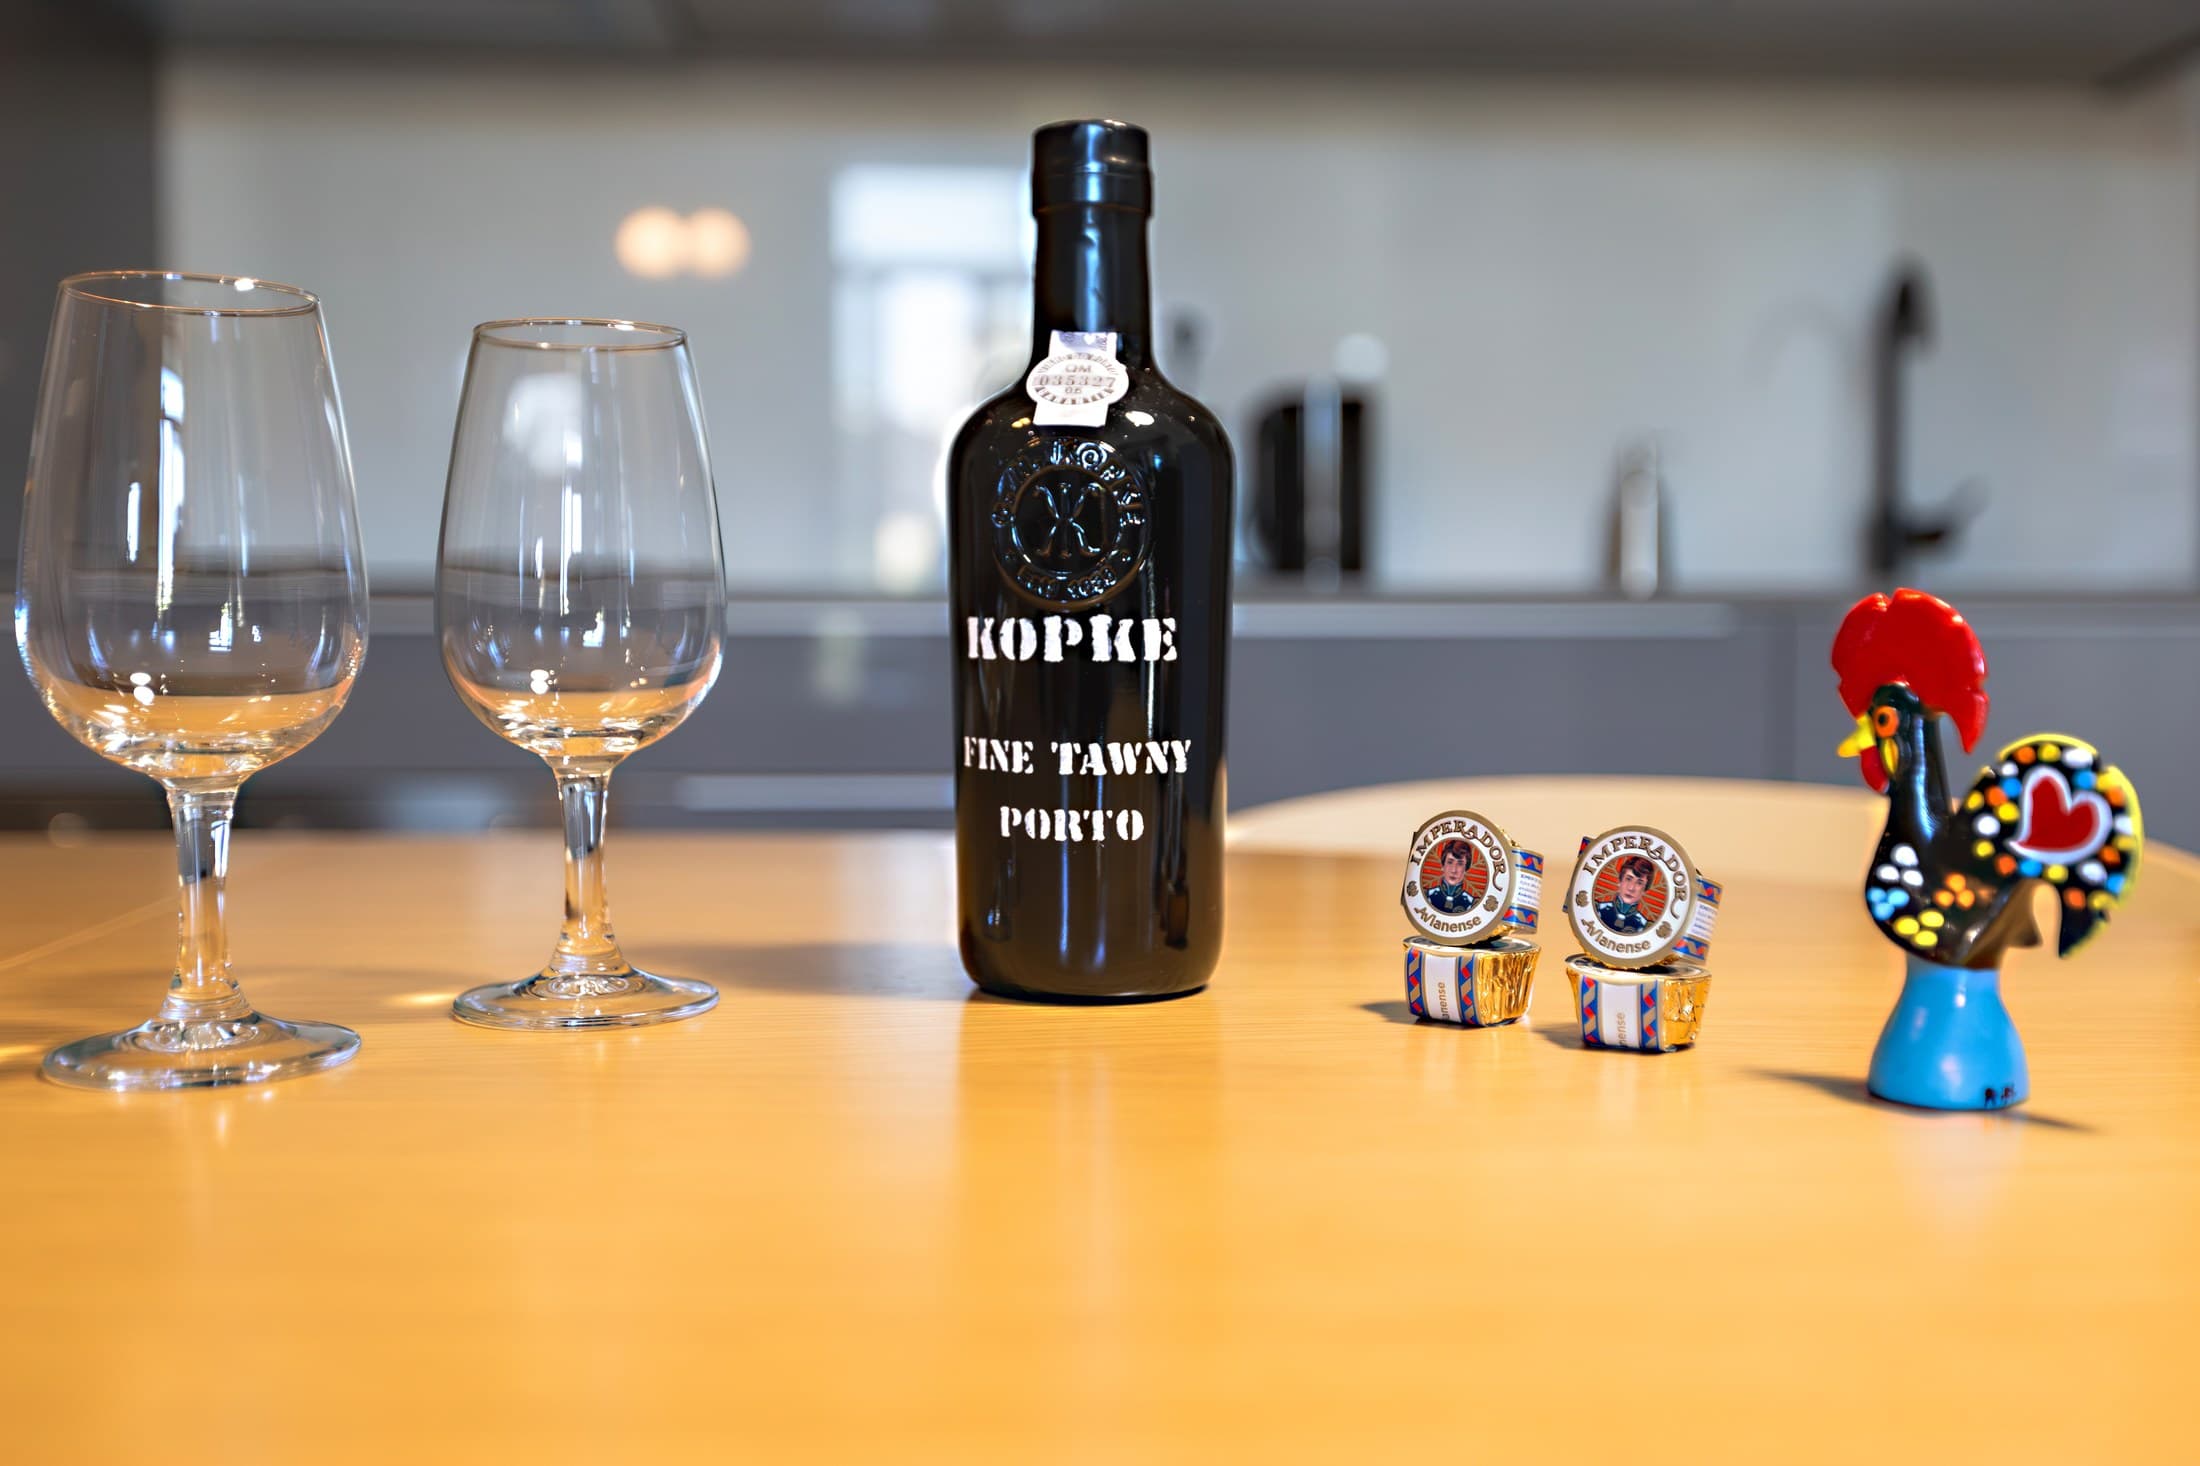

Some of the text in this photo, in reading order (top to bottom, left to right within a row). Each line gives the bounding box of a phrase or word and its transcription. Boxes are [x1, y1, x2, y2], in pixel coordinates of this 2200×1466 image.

[967, 614, 1178, 662] KOPKE
[963, 736, 1191, 776] FINE TAWNY
[1000, 806, 1145, 842] PORTO
[1410, 819, 1507, 892] IMPERADOR
[1582, 835, 1688, 920] IMPERADOR
